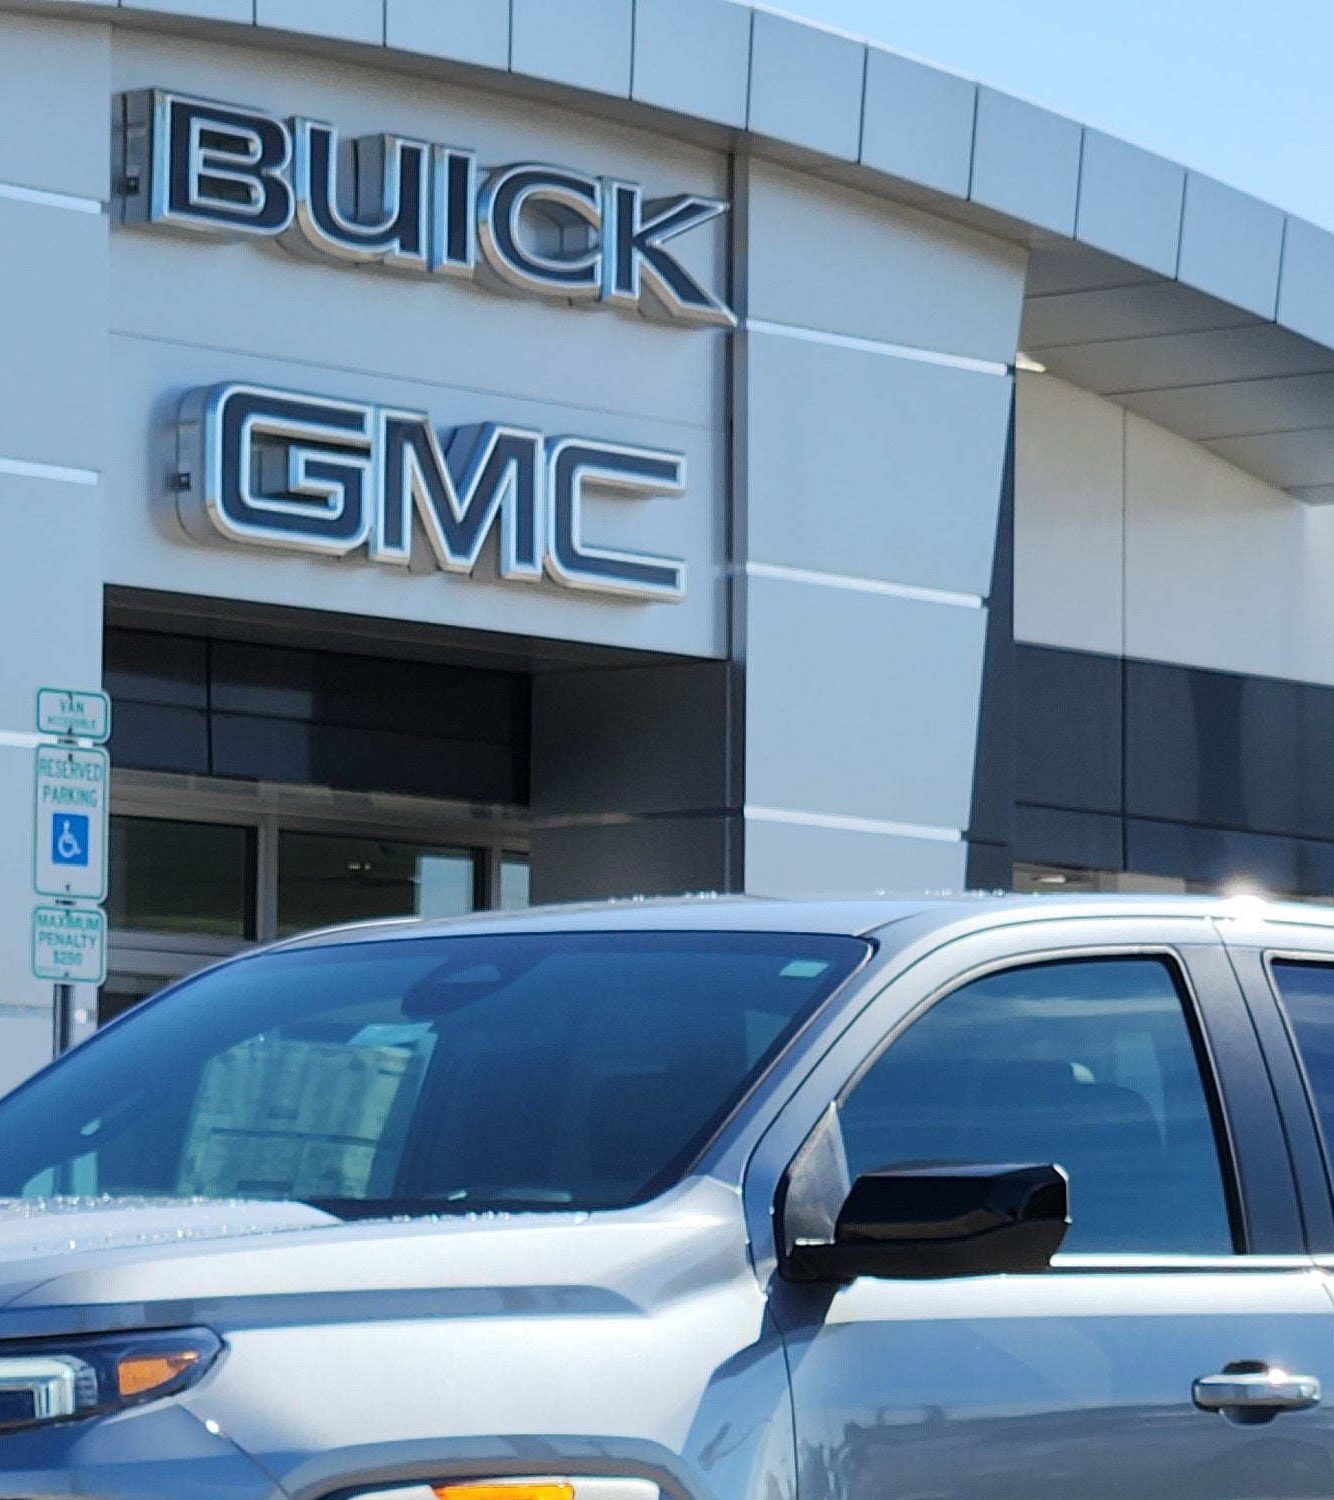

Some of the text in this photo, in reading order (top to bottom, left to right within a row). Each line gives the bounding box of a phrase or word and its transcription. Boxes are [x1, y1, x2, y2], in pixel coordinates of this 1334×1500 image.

[139, 87, 738, 327] BUICK
[197, 380, 687, 604] GMC
[58, 699, 86, 715] VAN
[39, 758, 102, 783] RESERVED
[43, 784, 98, 808] PARKING
[36, 913, 100, 930] MAXIMUM
[38, 930, 97, 948] PENALTY
